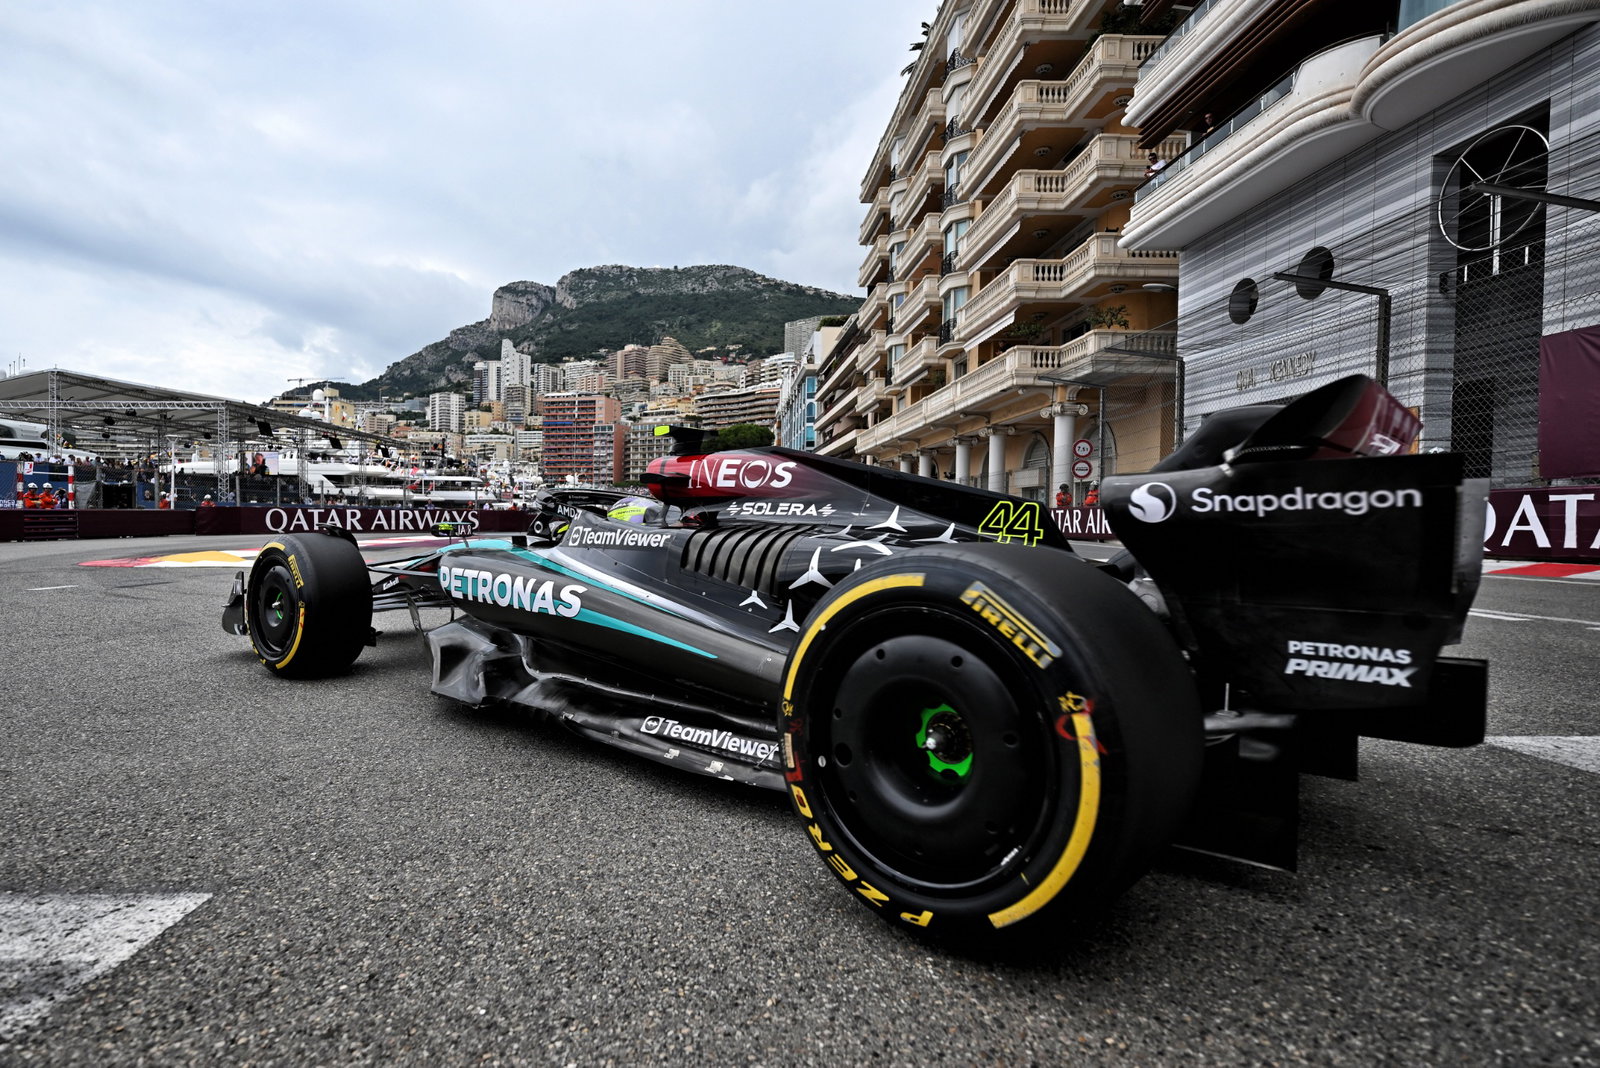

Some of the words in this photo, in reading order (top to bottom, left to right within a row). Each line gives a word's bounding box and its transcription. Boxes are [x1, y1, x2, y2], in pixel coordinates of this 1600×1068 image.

[688, 459, 797, 488] INEOS
[557, 504, 576, 518] AMD
[740, 502, 817, 516] SOLERA
[1191, 486, 1423, 518] Snapdragon
[265, 508, 362, 533] QATAR
[371, 509, 479, 531] AIRWAYS
[978, 501, 1044, 547] 44
[583, 529, 670, 548] TeamViewer
[440, 566, 588, 618] PETRONAS
[960, 580, 1063, 669] PIRELLI
[1288, 640, 1412, 664] PETRONAS
[1284, 658, 1419, 688] PRIMAX
[663, 720, 779, 760] TeamViewer
[790, 783, 890, 908] ZERO
